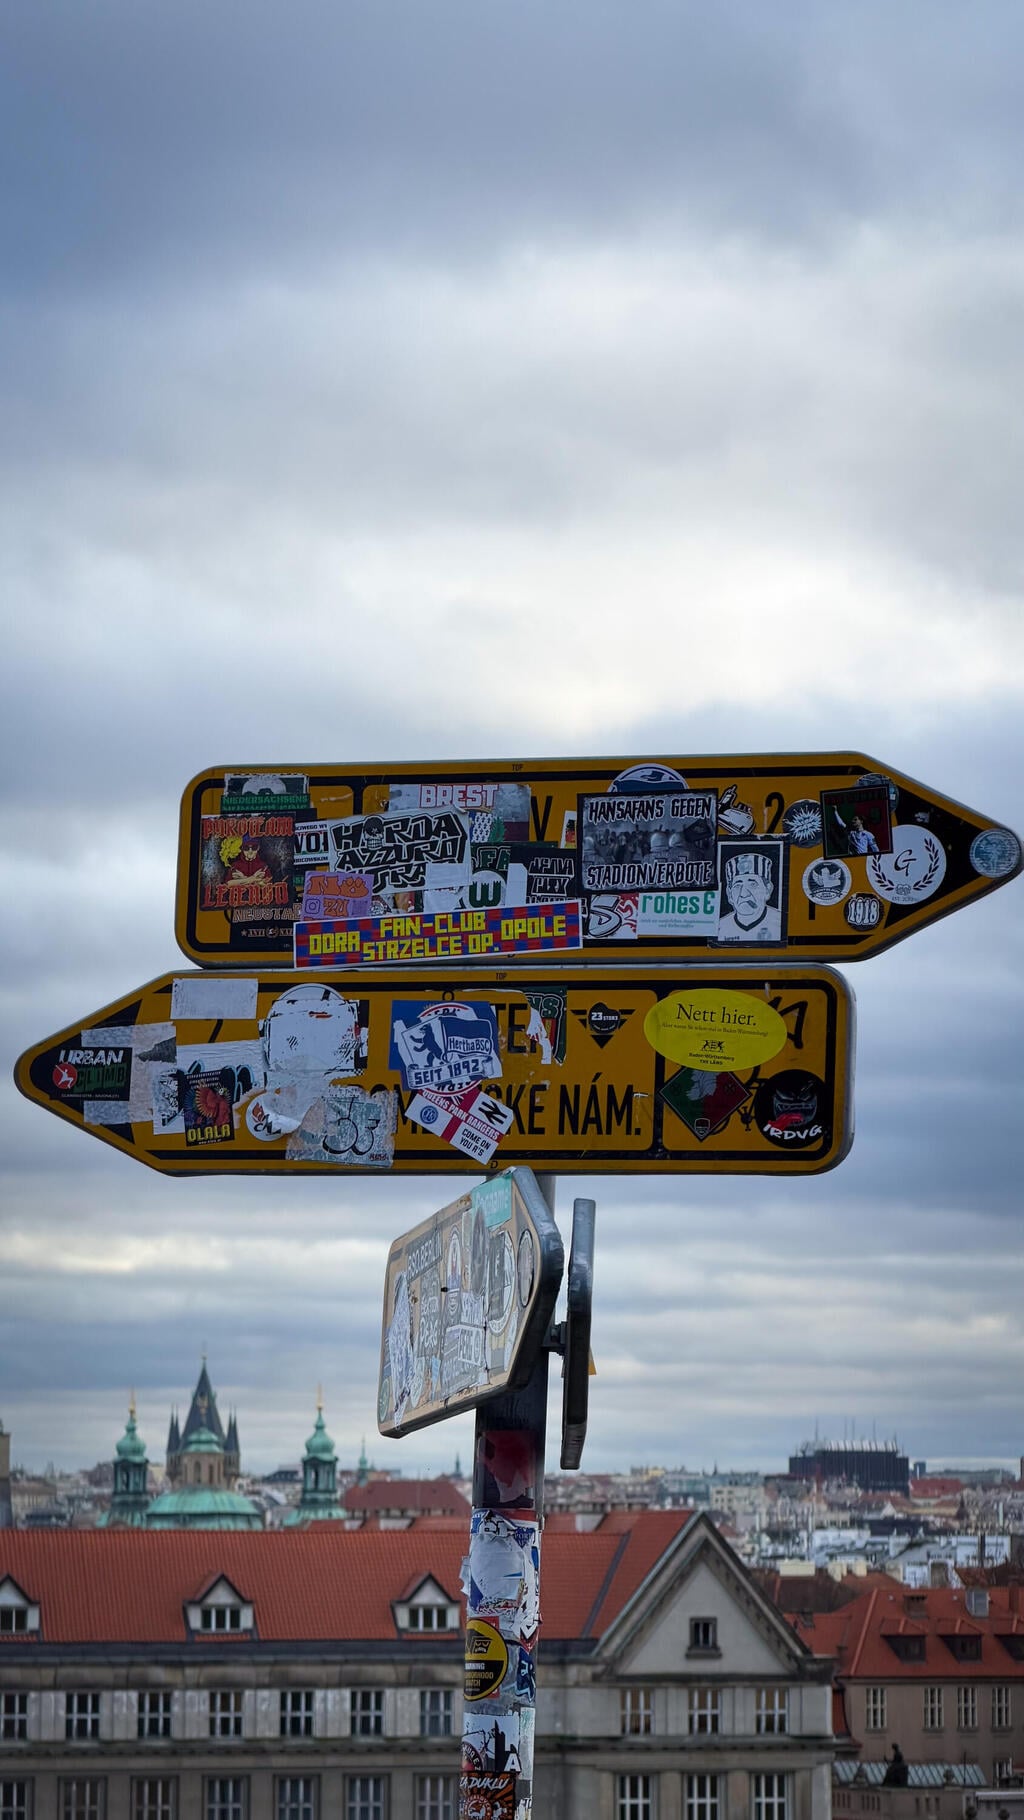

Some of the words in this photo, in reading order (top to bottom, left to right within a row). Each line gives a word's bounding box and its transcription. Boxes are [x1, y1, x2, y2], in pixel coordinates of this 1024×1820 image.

[419, 784, 499, 809] BREST
[588, 798, 665, 825] HANSAFANS
[671, 795, 713, 819] GEGEN
[587, 861, 713, 889] STADIONVERBOTE
[847, 896, 881, 926] 1918
[380, 911, 486, 938] FAN-CLUB
[501, 915, 566, 941] OPOLE
[309, 930, 361, 955] ODRA
[363, 935, 463, 961] STRZELCE
[591, 1012, 603, 1021] 23
[676, 1003, 716, 1022] Nett
[721, 1006, 757, 1026] hier.
[58, 1049, 124, 1066] URBAN
[475, 1038, 491, 1052] BSC
[77, 1066, 125, 1088] CLIMB
[413, 1069, 442, 1085] SEIT
[447, 1058, 479, 1078] 1892
[422, 1089, 450, 1110] QUEENS
[447, 1104, 467, 1121] PARK
[466, 1115, 500, 1141] RANGERS
[558, 1072, 642, 1136] NÁM.
[187, 1124, 231, 1142] OLALA
[459, 1137, 473, 1149] YOU
[462, 1128, 481, 1144] COME
[480, 1138, 492, 1150] ON
